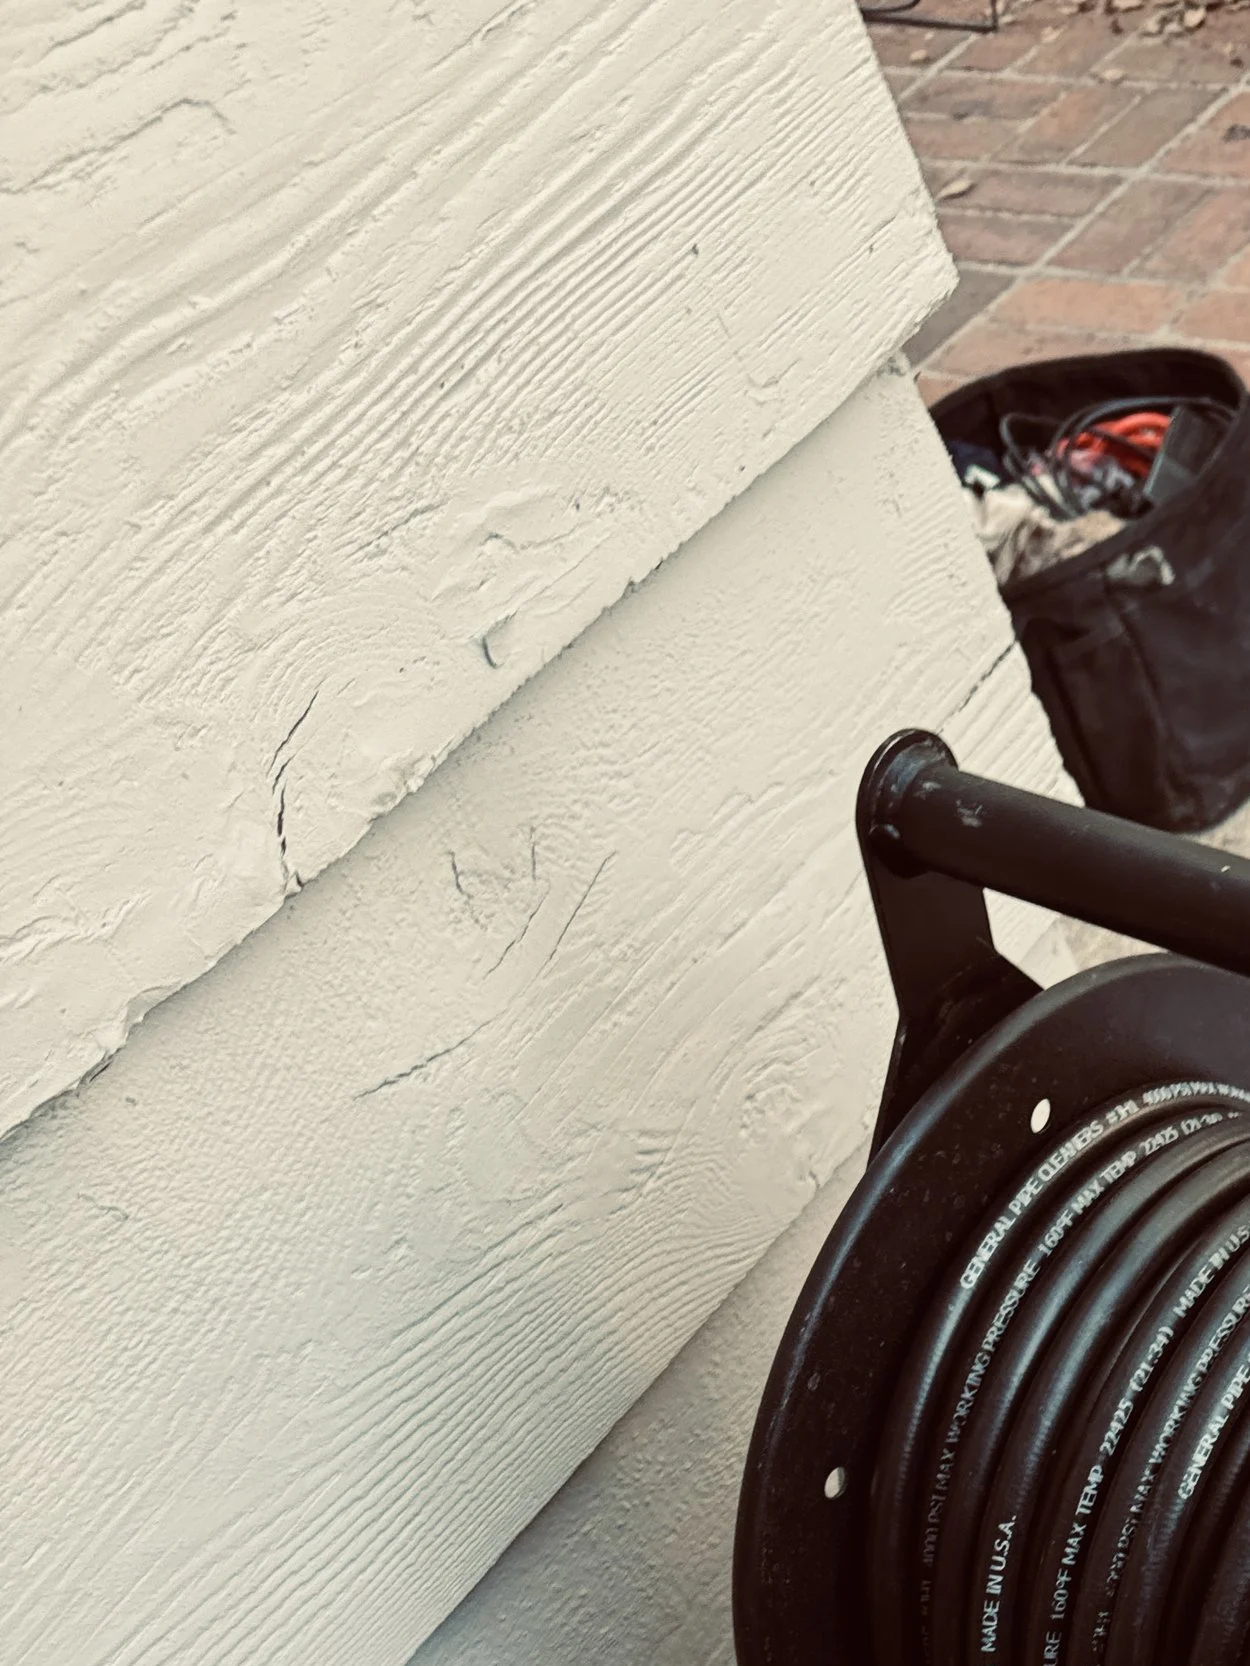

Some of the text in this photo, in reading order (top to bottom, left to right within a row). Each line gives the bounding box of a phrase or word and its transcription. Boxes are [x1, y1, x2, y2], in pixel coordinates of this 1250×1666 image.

[1071, 1179, 1104, 1215] MAX
[1100, 1150, 1136, 1183] TEMP
[960, 1216, 1016, 1289] GENERAL
[1009, 1177, 1043, 1215] PIPE
[1038, 1120, 1103, 1181] CLEANERS
[981, 1258, 1041, 1352] PRESSURE
[945, 1351, 991, 1443] WORKING
[1062, 1522, 1087, 1566] MAX
[1075, 1464, 1104, 1516] TEMP
[1100, 1398, 1134, 1456] 22425
[1173, 1264, 1215, 1318] MADE
[935, 1448, 956, 1490] MAX
[1129, 1466, 1158, 1516] MAX
[1148, 1373, 1202, 1464] WORKING
[1178, 1414, 1231, 1500] GENERAL
[989, 1514, 1017, 1571] U.S.A.
[986, 1574, 1004, 1596] IN
[980, 1599, 1004, 1652] MADE
